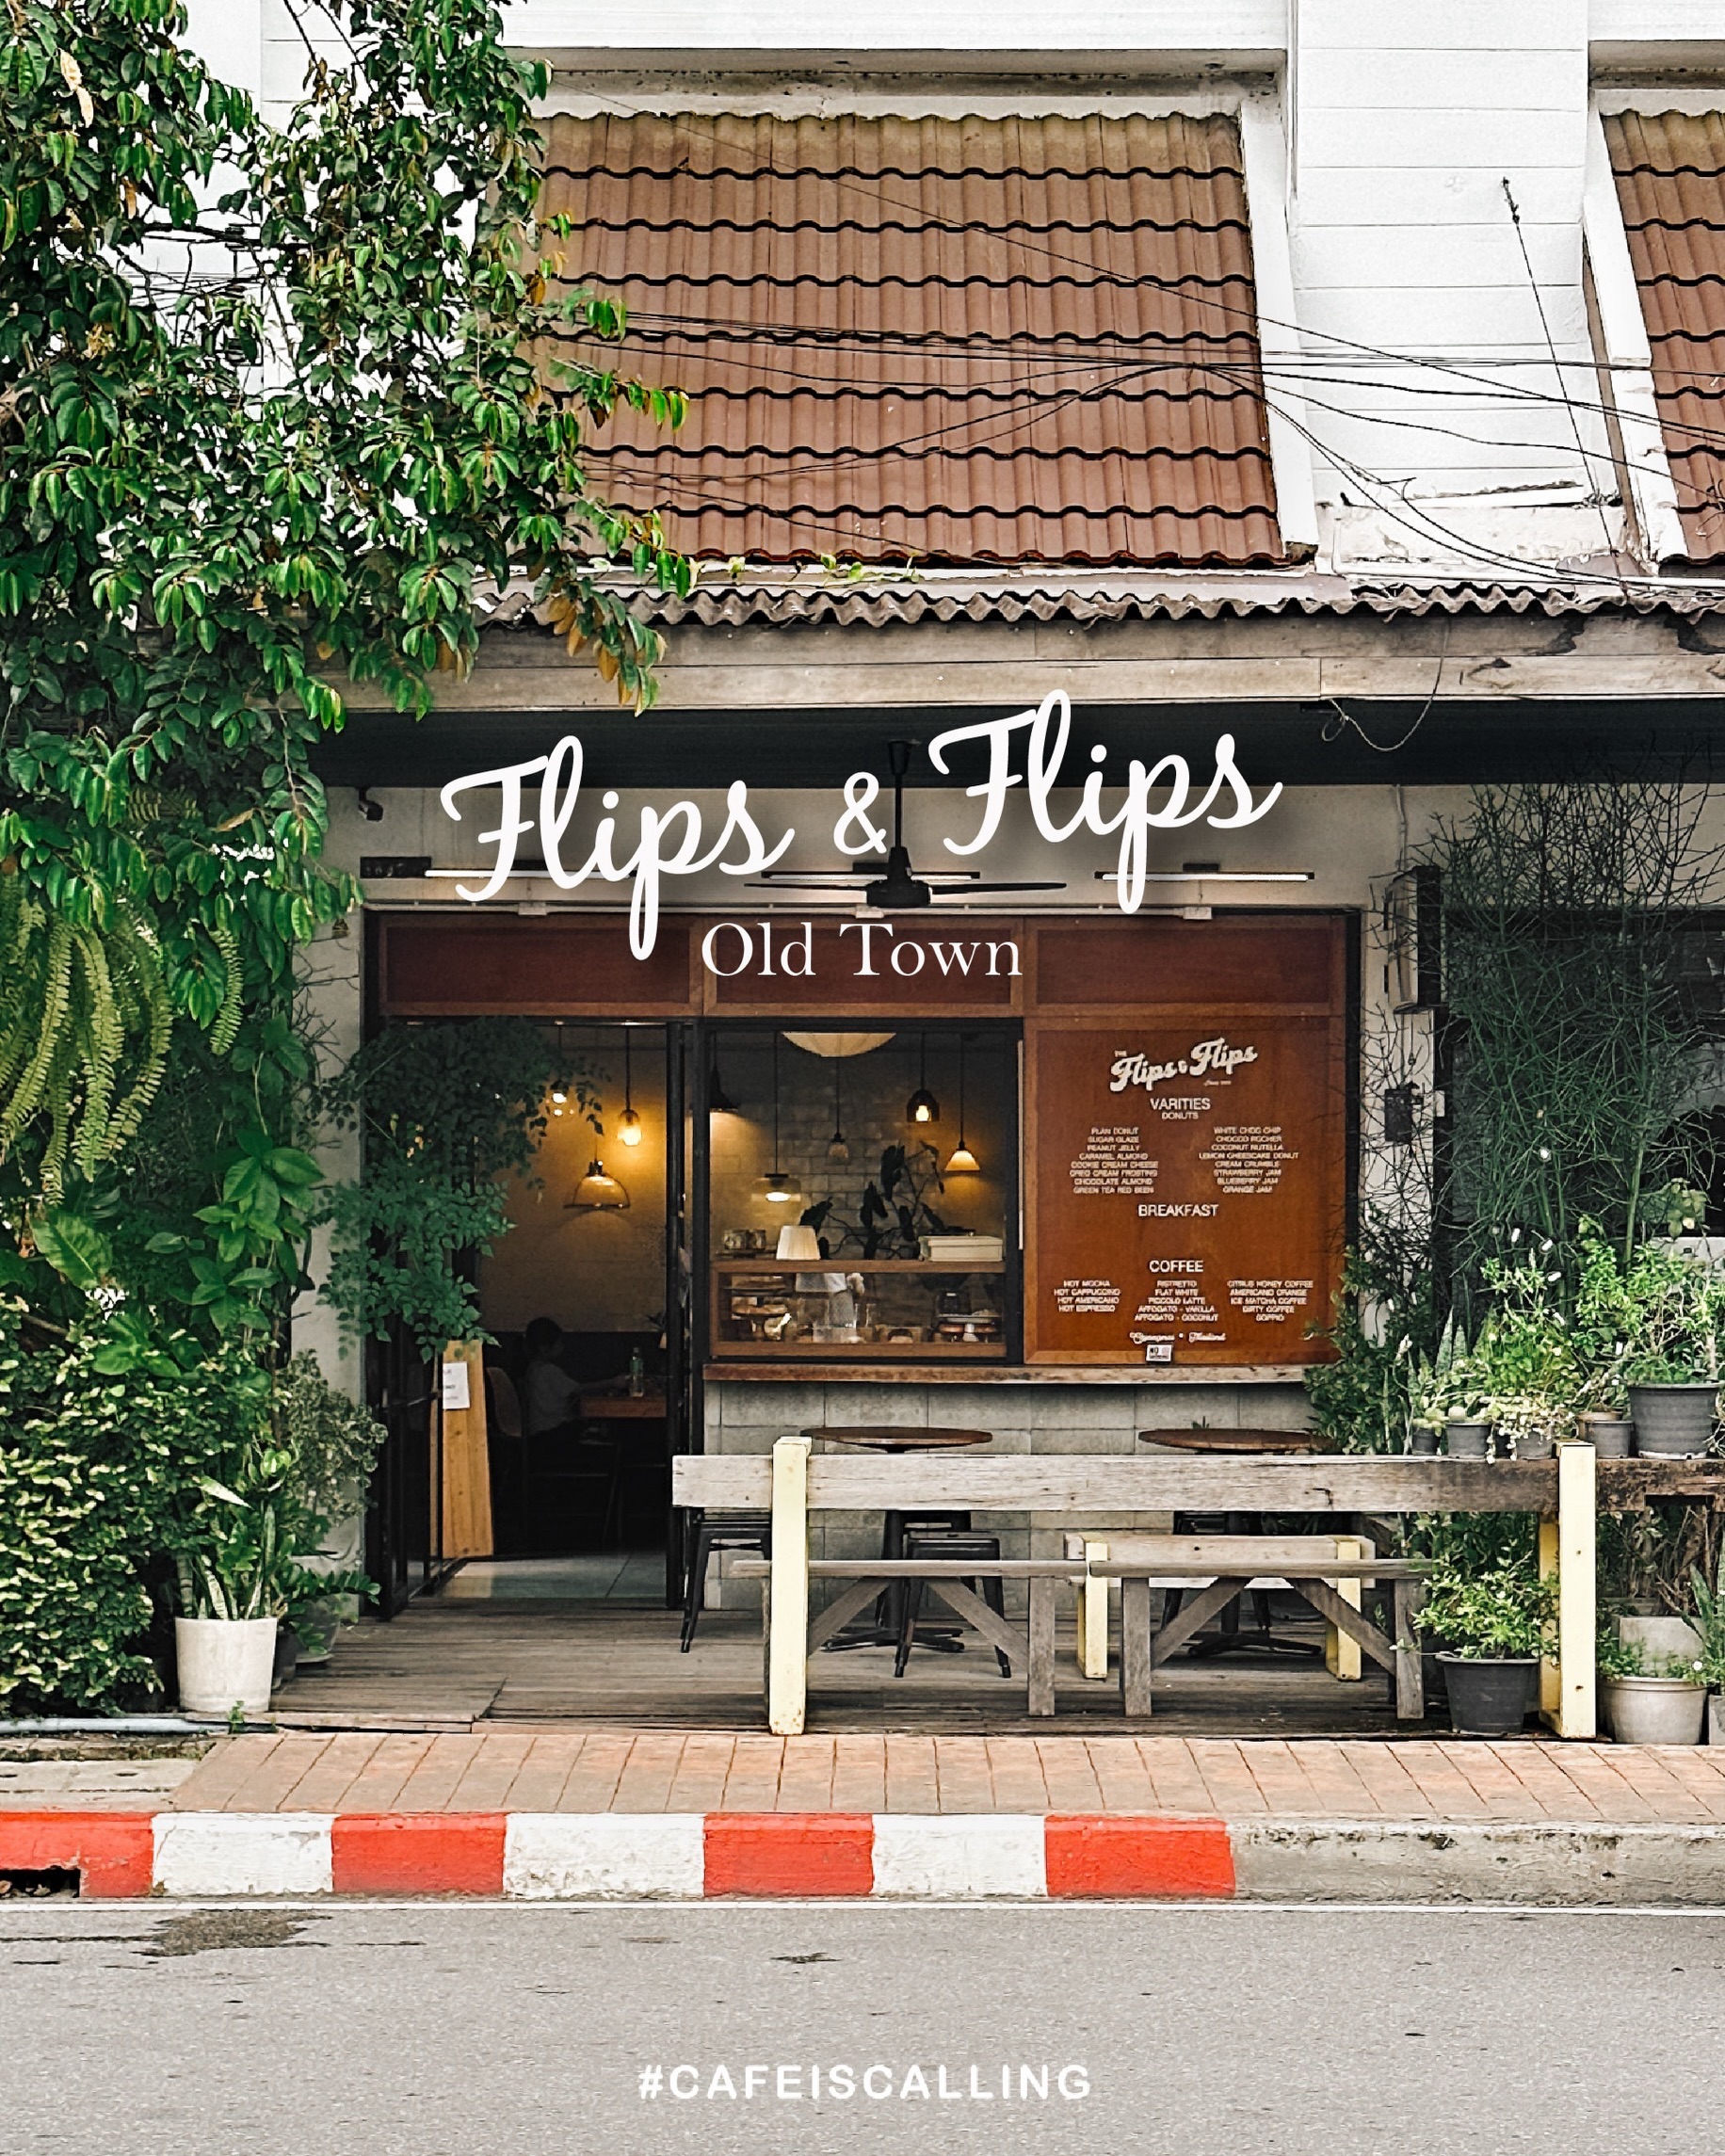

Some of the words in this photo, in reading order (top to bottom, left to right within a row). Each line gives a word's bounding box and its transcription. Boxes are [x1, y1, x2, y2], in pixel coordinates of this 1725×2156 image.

[1110, 1053, 1178, 1091] Flips
[1190, 1037, 1258, 1075] Flips
[1151, 1098, 1211, 1111] VARITIES
[1162, 1112, 1199, 1120] DONUTS
[1113, 1126, 1139, 1135] DONUT
[1214, 1126, 1238, 1134] WHITE
[1088, 1135, 1114, 1144] SUGAR
[1115, 1135, 1139, 1144] GLAZE
[1087, 1144, 1116, 1152] PEANUT
[1118, 1144, 1140, 1152] JELLY
[1079, 1152, 1116, 1161] CARAMEL
[1137, 1204, 1219, 1217] BREAKFAST
[1149, 1260, 1203, 1273] COFFEE
[1063, 1279, 1080, 1288] HOT
[1082, 1279, 1110, 1288] MOCHA
[1054, 1288, 1070, 1296] HOT
[1154, 1288, 1173, 1296] FLAT
[1174, 1288, 1199, 1296] WHITE
[1057, 1296, 1073, 1305] HOT
[1182, 1296, 1206, 1305] LATTE
[1058, 1304, 1074, 1312] HOT
